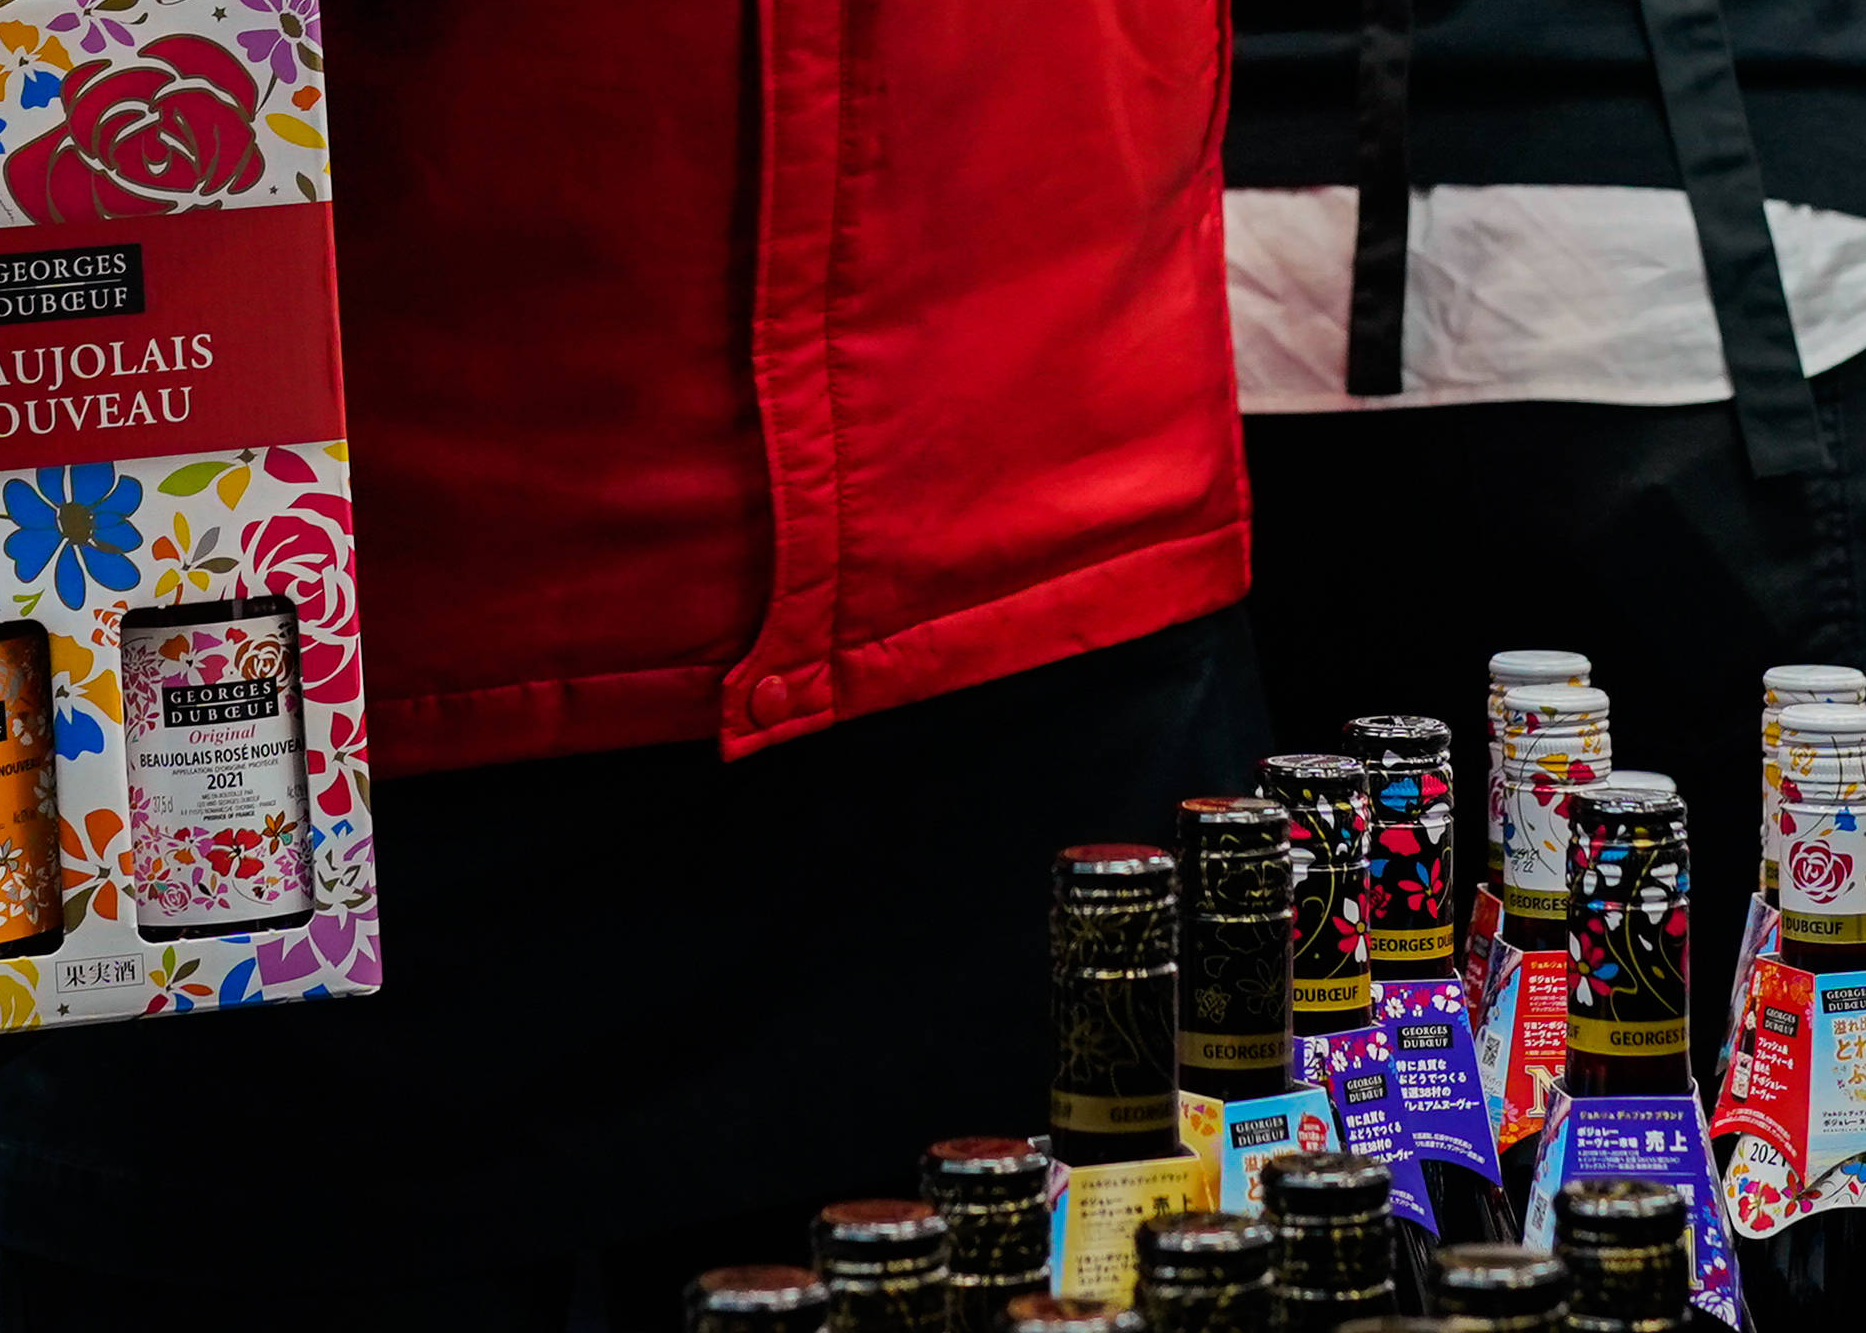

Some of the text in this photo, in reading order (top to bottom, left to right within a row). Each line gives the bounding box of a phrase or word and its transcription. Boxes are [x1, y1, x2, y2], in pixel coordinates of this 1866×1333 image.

[170, 681, 272, 705] GEORGES
[171, 701, 274, 724] DUBŒUF
[189, 724, 257, 745] Original
[140, 750, 212, 768] BEAUJOLAIS
[214, 742, 249, 764] ROSÉ
[206, 771, 244, 790] 2021
[1786, 916, 1844, 935] DUBŒUF
[1371, 936, 1434, 952] GEORGES
[64, 959, 136, 987] 果実酒
[1293, 985, 1358, 1003] DUBŒUF
[1401, 1025, 1448, 1037] GEORGES
[1610, 1028, 1679, 1046] GEORGES
[1203, 1039, 1277, 1061] GEORGES
[1235, 1116, 1284, 1134] GEORGES
